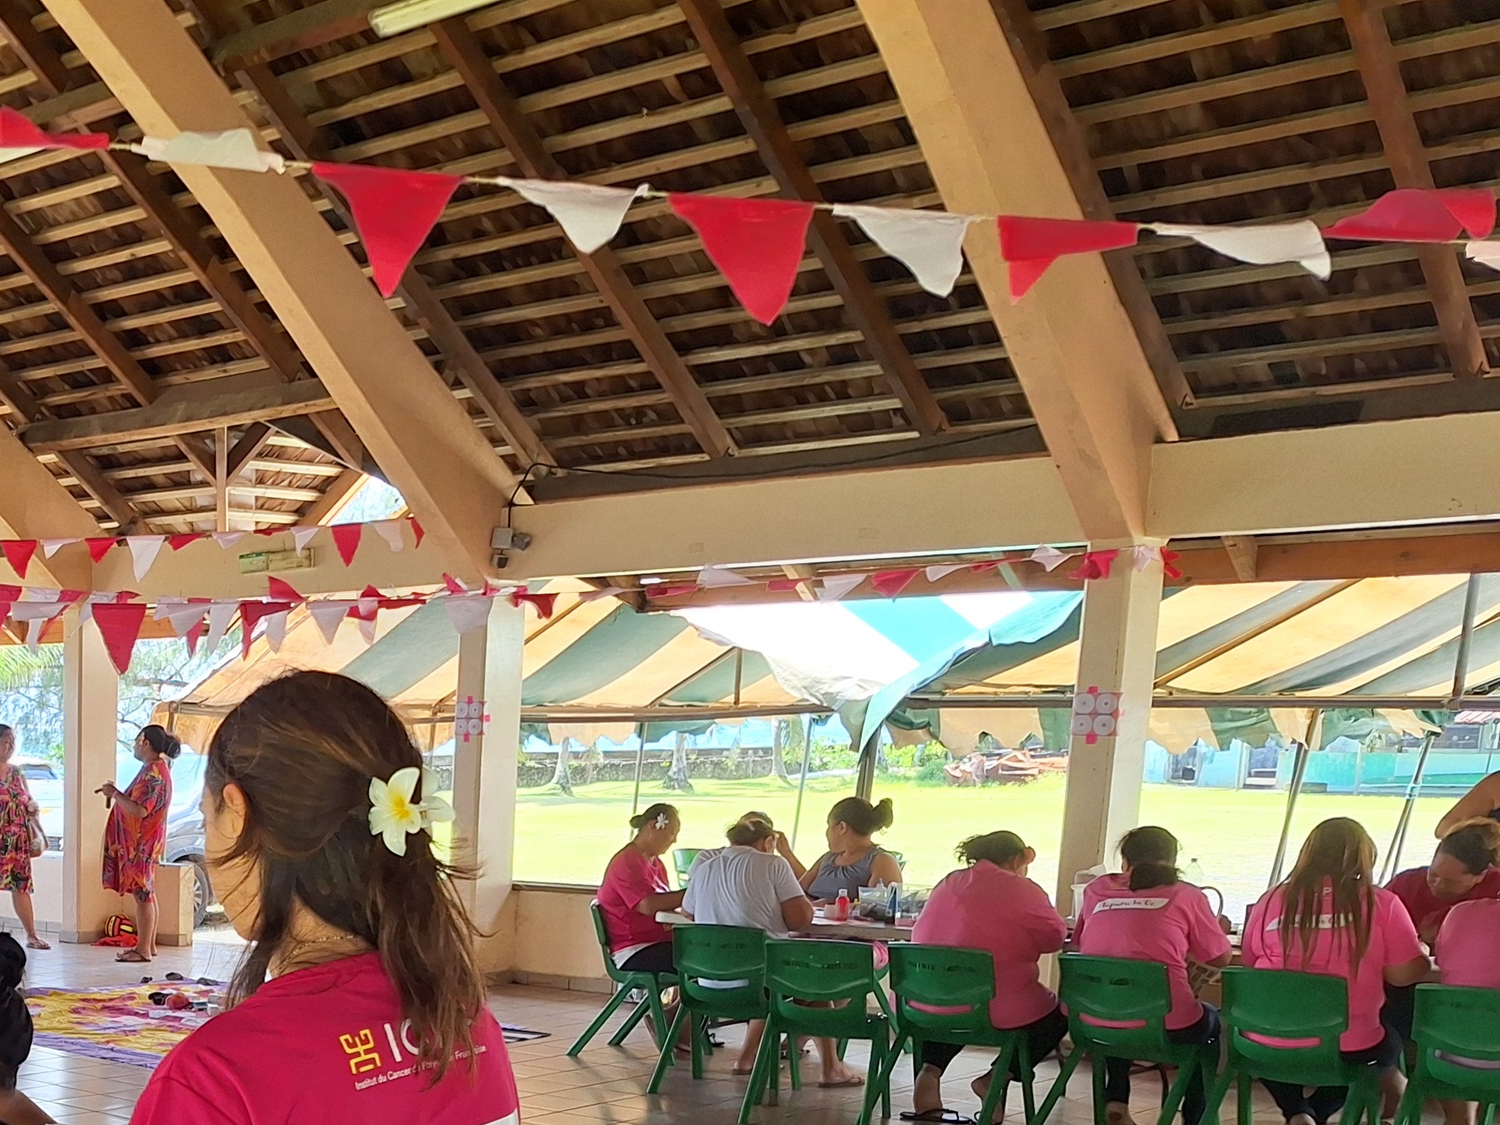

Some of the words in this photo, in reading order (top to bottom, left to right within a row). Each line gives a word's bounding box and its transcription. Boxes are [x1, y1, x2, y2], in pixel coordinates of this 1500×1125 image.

[354, 1076, 378, 1091] Institut
[378, 1073, 387, 1083] du
[387, 1067, 412, 1080] Cancer
